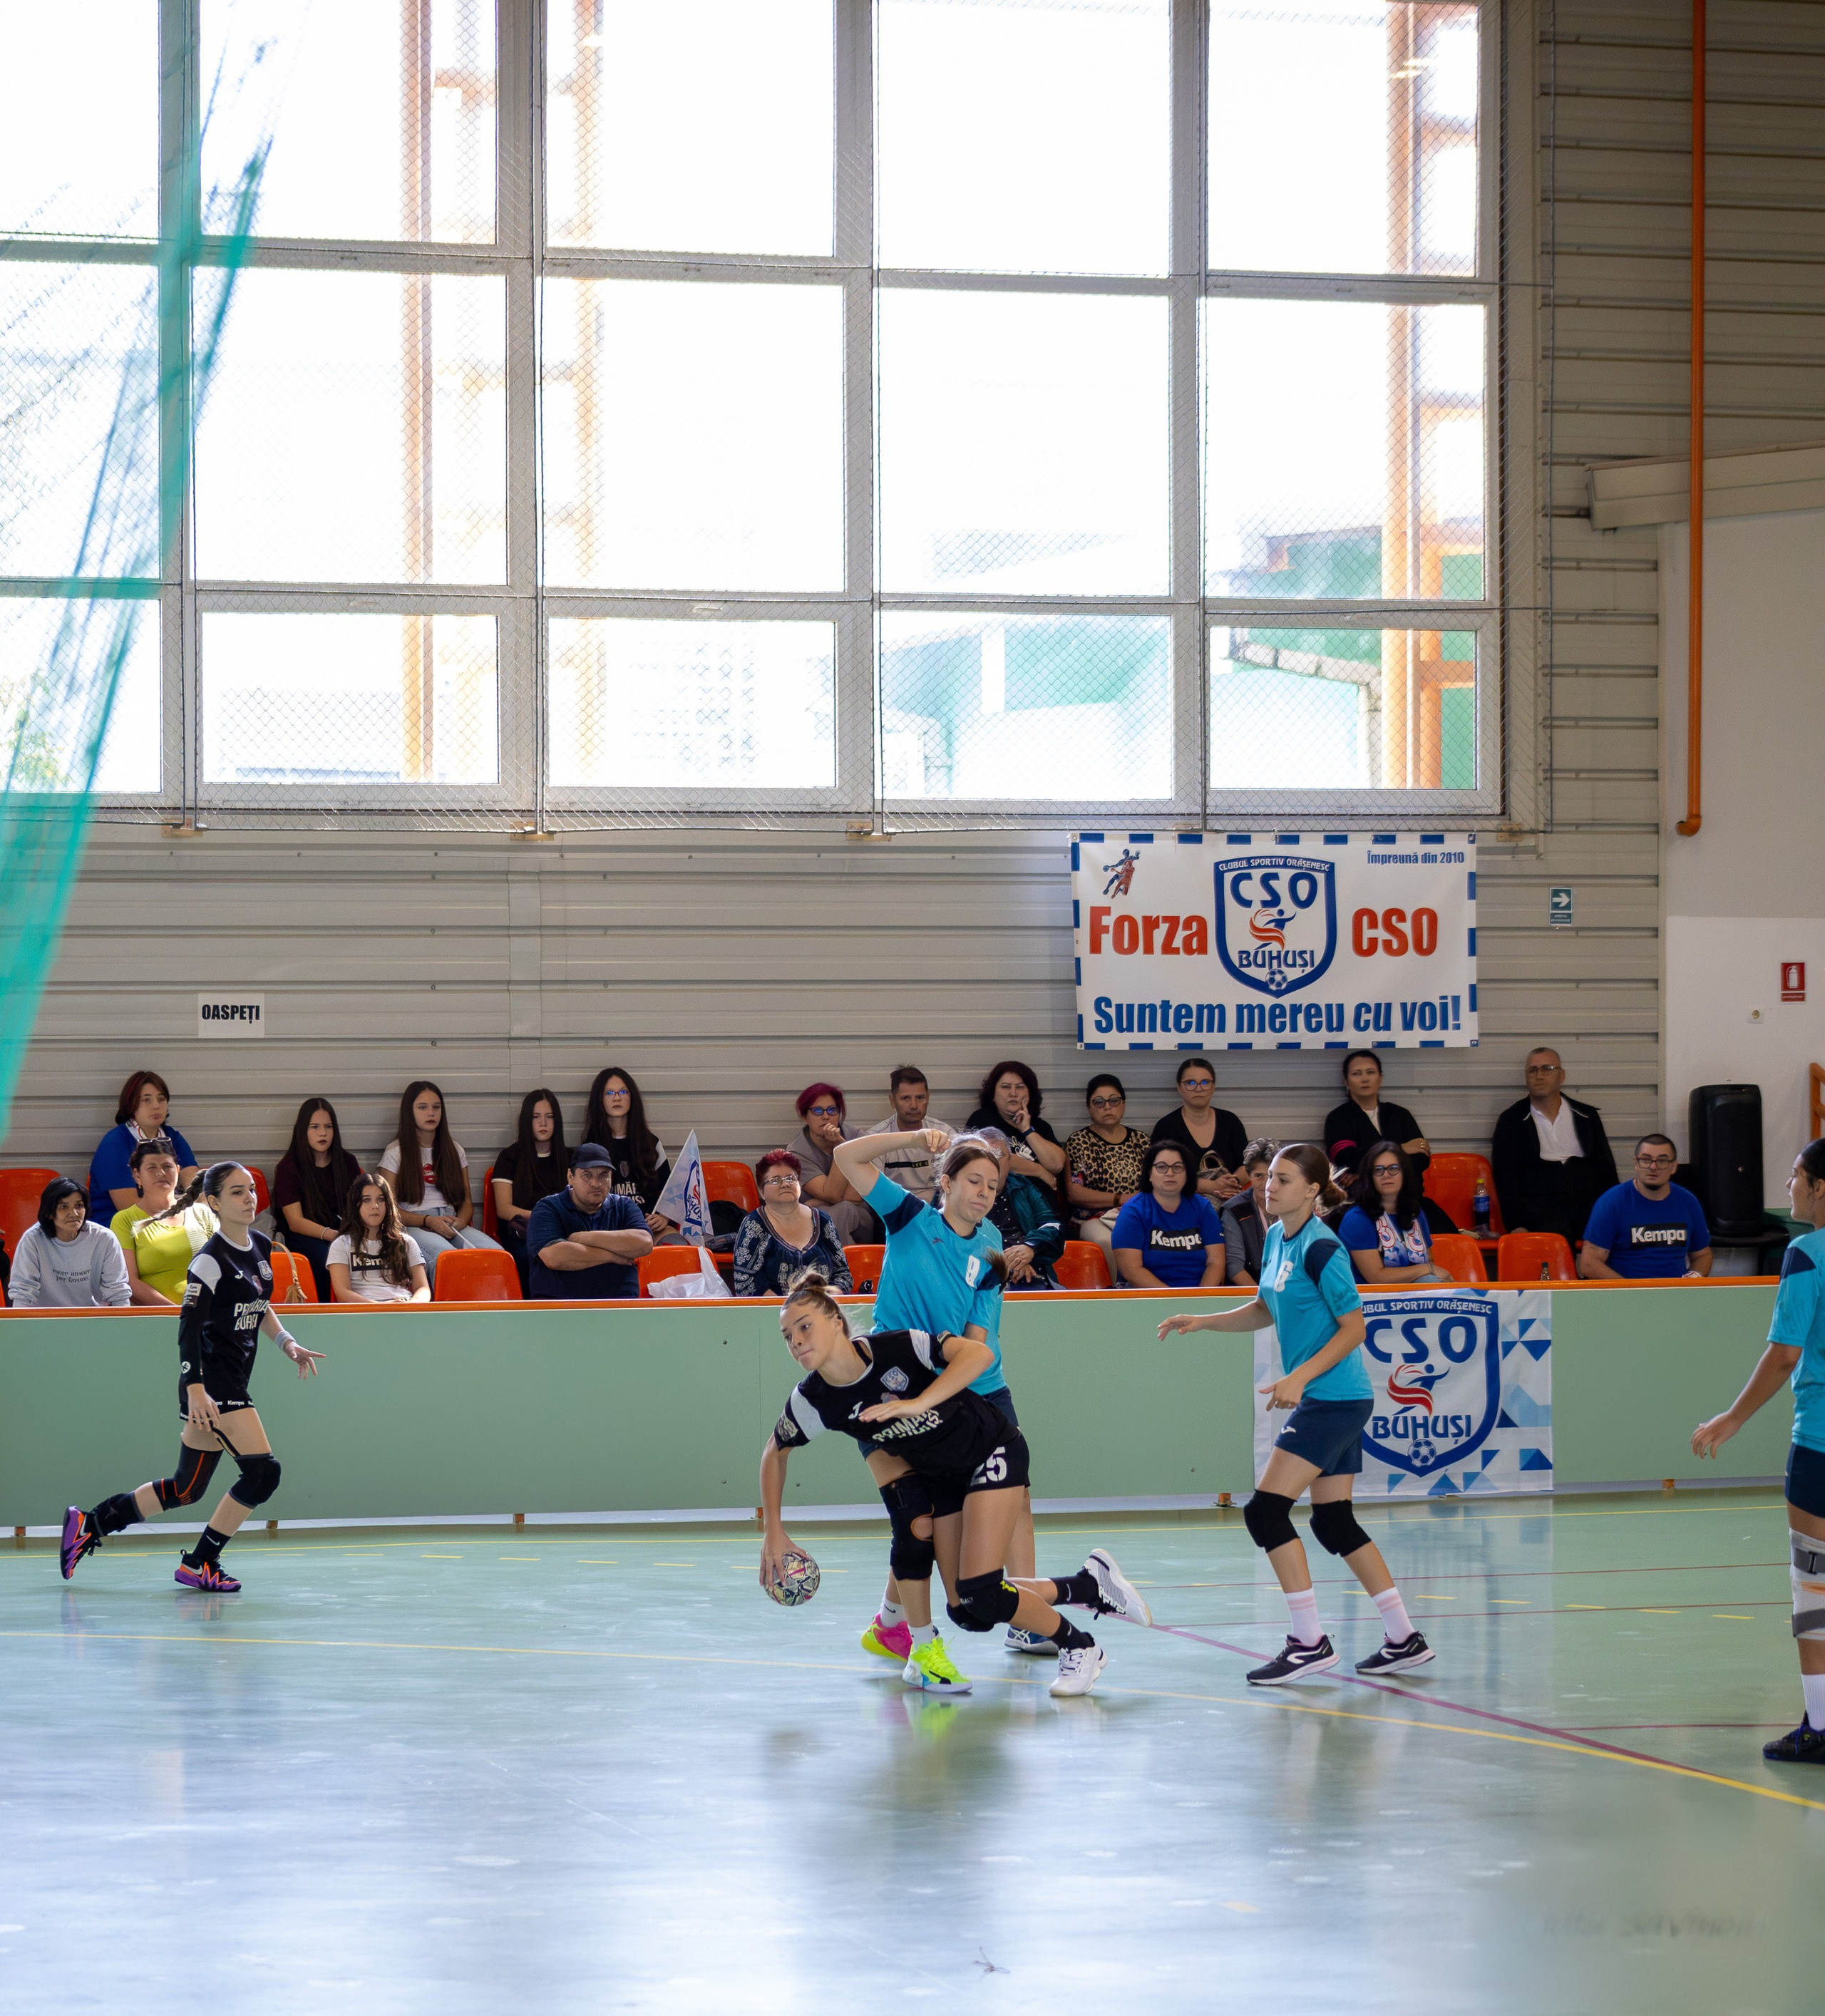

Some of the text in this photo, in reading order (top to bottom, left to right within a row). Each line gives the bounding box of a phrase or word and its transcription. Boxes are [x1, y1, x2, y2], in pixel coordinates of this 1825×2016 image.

[1218, 860, 1248, 871] CLUBUL
[1250, 858, 1285, 867] SPORTIV
[1367, 850, 1464, 865] Împreună din 2010
[1230, 872, 1318, 910] CSO
[1089, 906, 1208, 956] Forza
[1352, 907, 1438, 958] CSO
[202, 1004, 260, 1024] OASPEȚI
[1094, 994, 1461, 1034] Suntem mereu cu voi!
[1631, 1226, 1686, 1245] Kempa
[1274, 1260, 1294, 1292] 6
[1361, 1302, 1387, 1314] UBUL
[1390, 1300, 1434, 1312] SPORTIV
[1363, 1315, 1478, 1364] CSO
[970, 1446, 1007, 1486] 25
